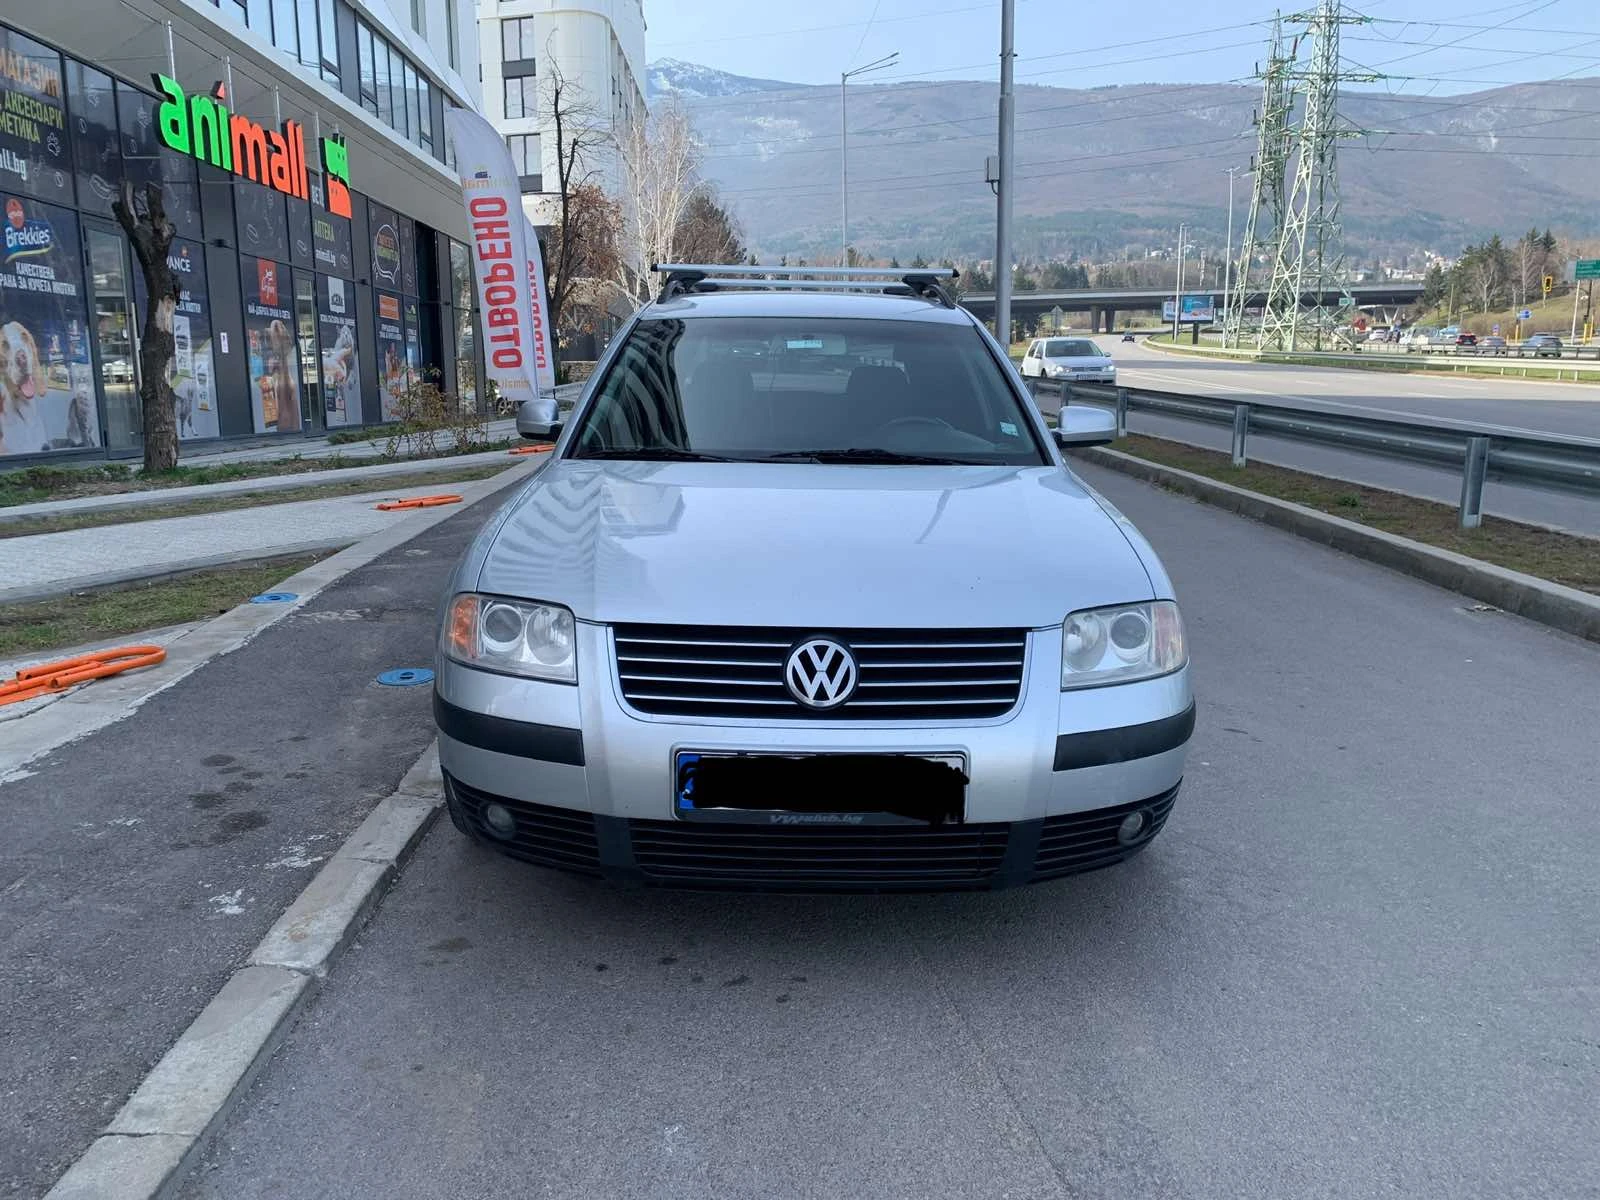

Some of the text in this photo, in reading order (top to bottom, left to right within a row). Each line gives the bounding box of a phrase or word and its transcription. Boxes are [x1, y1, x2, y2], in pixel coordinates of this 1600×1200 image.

[4, 88, 63, 130] АКСЕСОАРИ
[153, 73, 309, 201] animall
[5, 226, 51, 249] Brekkies
